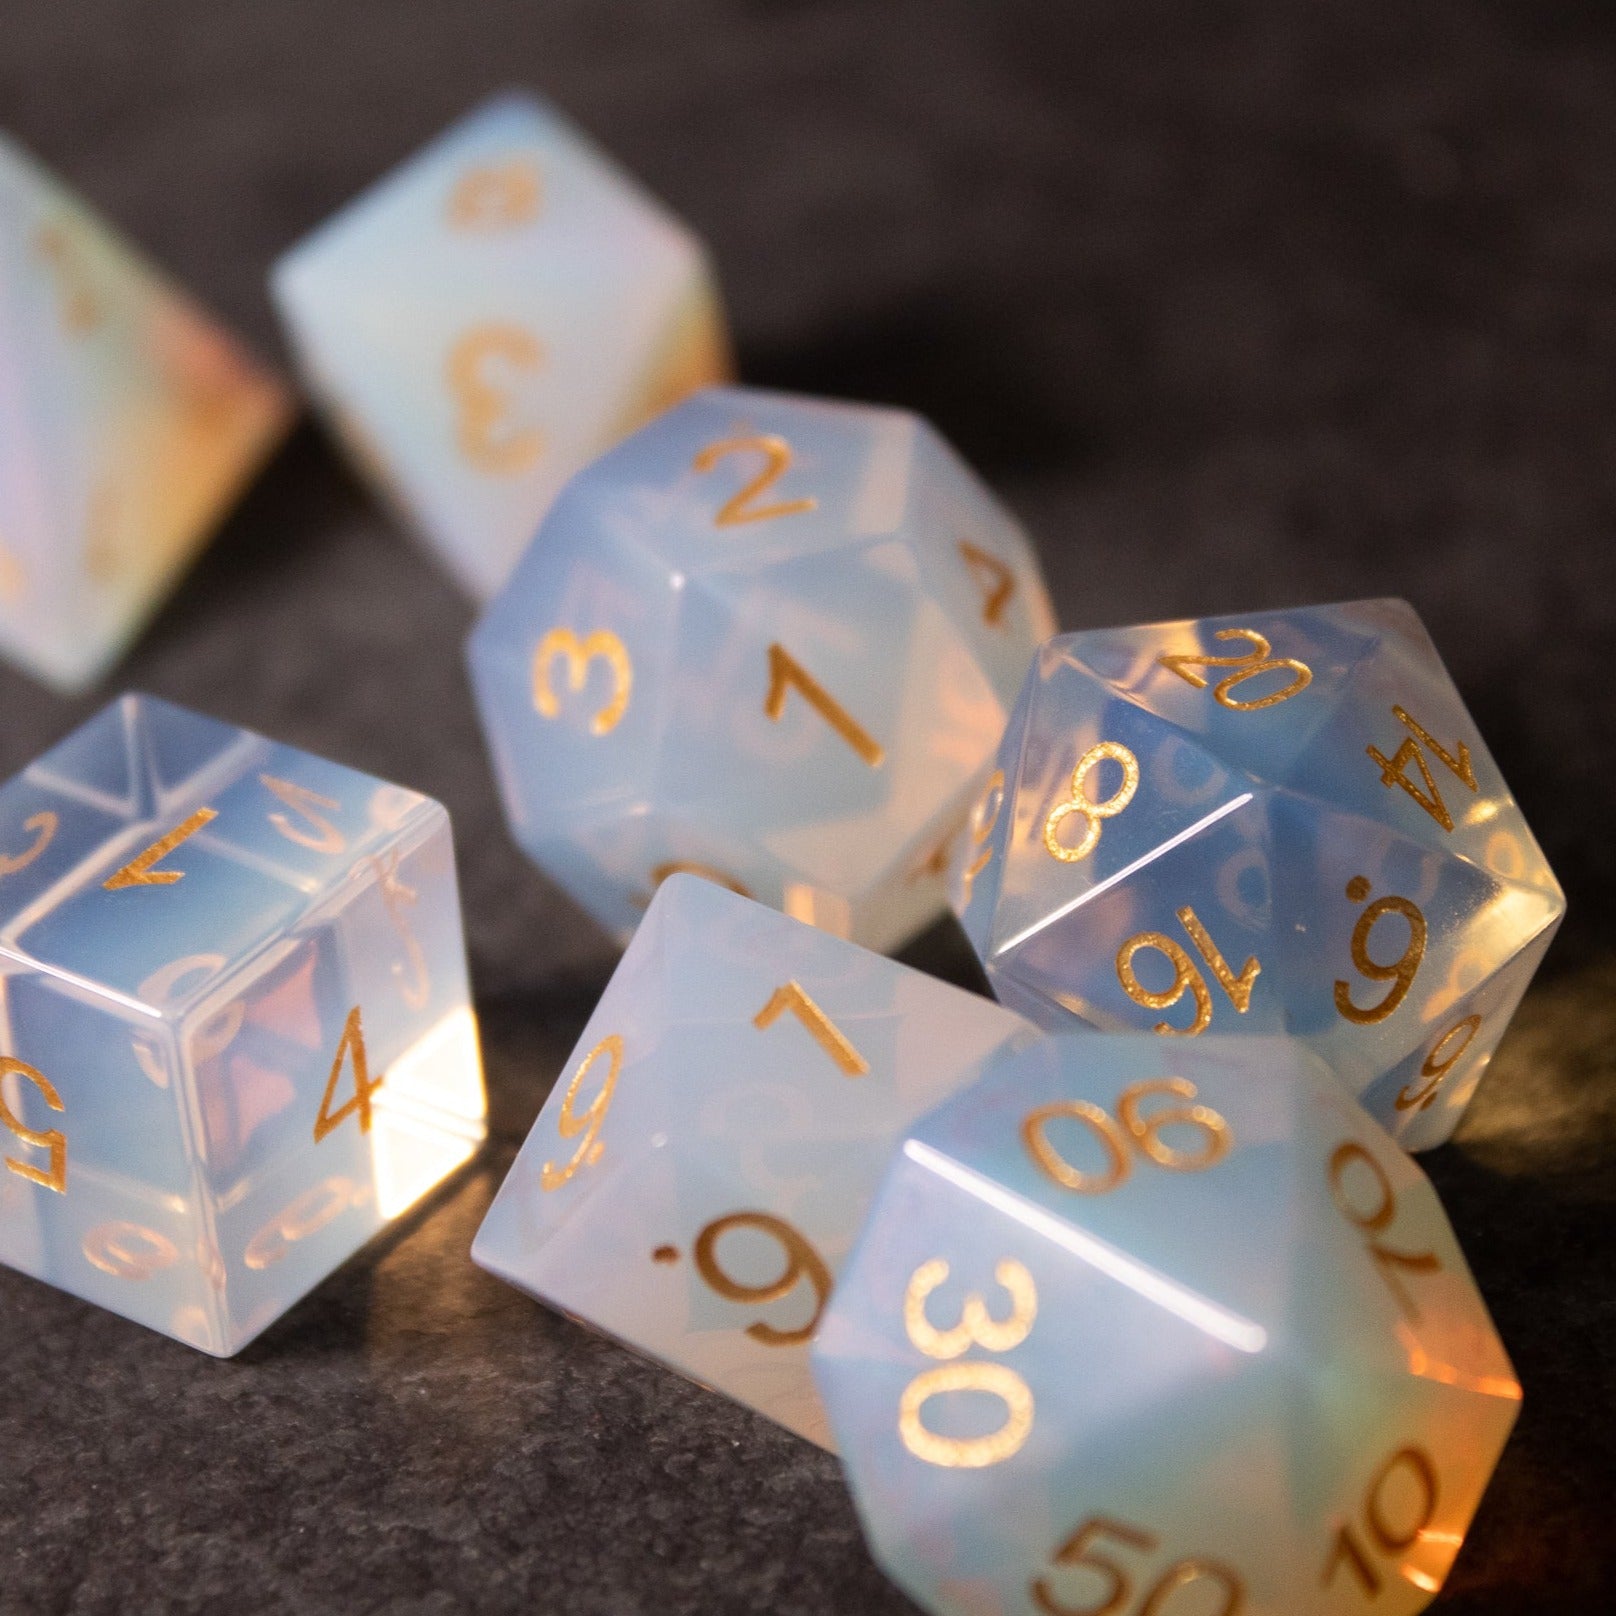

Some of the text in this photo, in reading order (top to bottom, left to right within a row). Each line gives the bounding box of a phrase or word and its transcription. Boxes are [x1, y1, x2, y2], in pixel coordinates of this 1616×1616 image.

[693, 434, 819, 528] 2
[532, 626, 634, 737] 3
[764, 643, 885, 767] 1
[1159, 628, 1312, 711] 20
[1044, 741, 1139, 863] 8
[1366, 704, 1479, 832] 14
[103, 807, 218, 891] 1
[1116, 906, 1261, 1036] 16
[0, 1056, 67, 1195] 5
[313, 1005, 383, 1144] 4
[899, 1258, 1038, 1468] 30
[1321, 1446, 1440, 1599] 10
